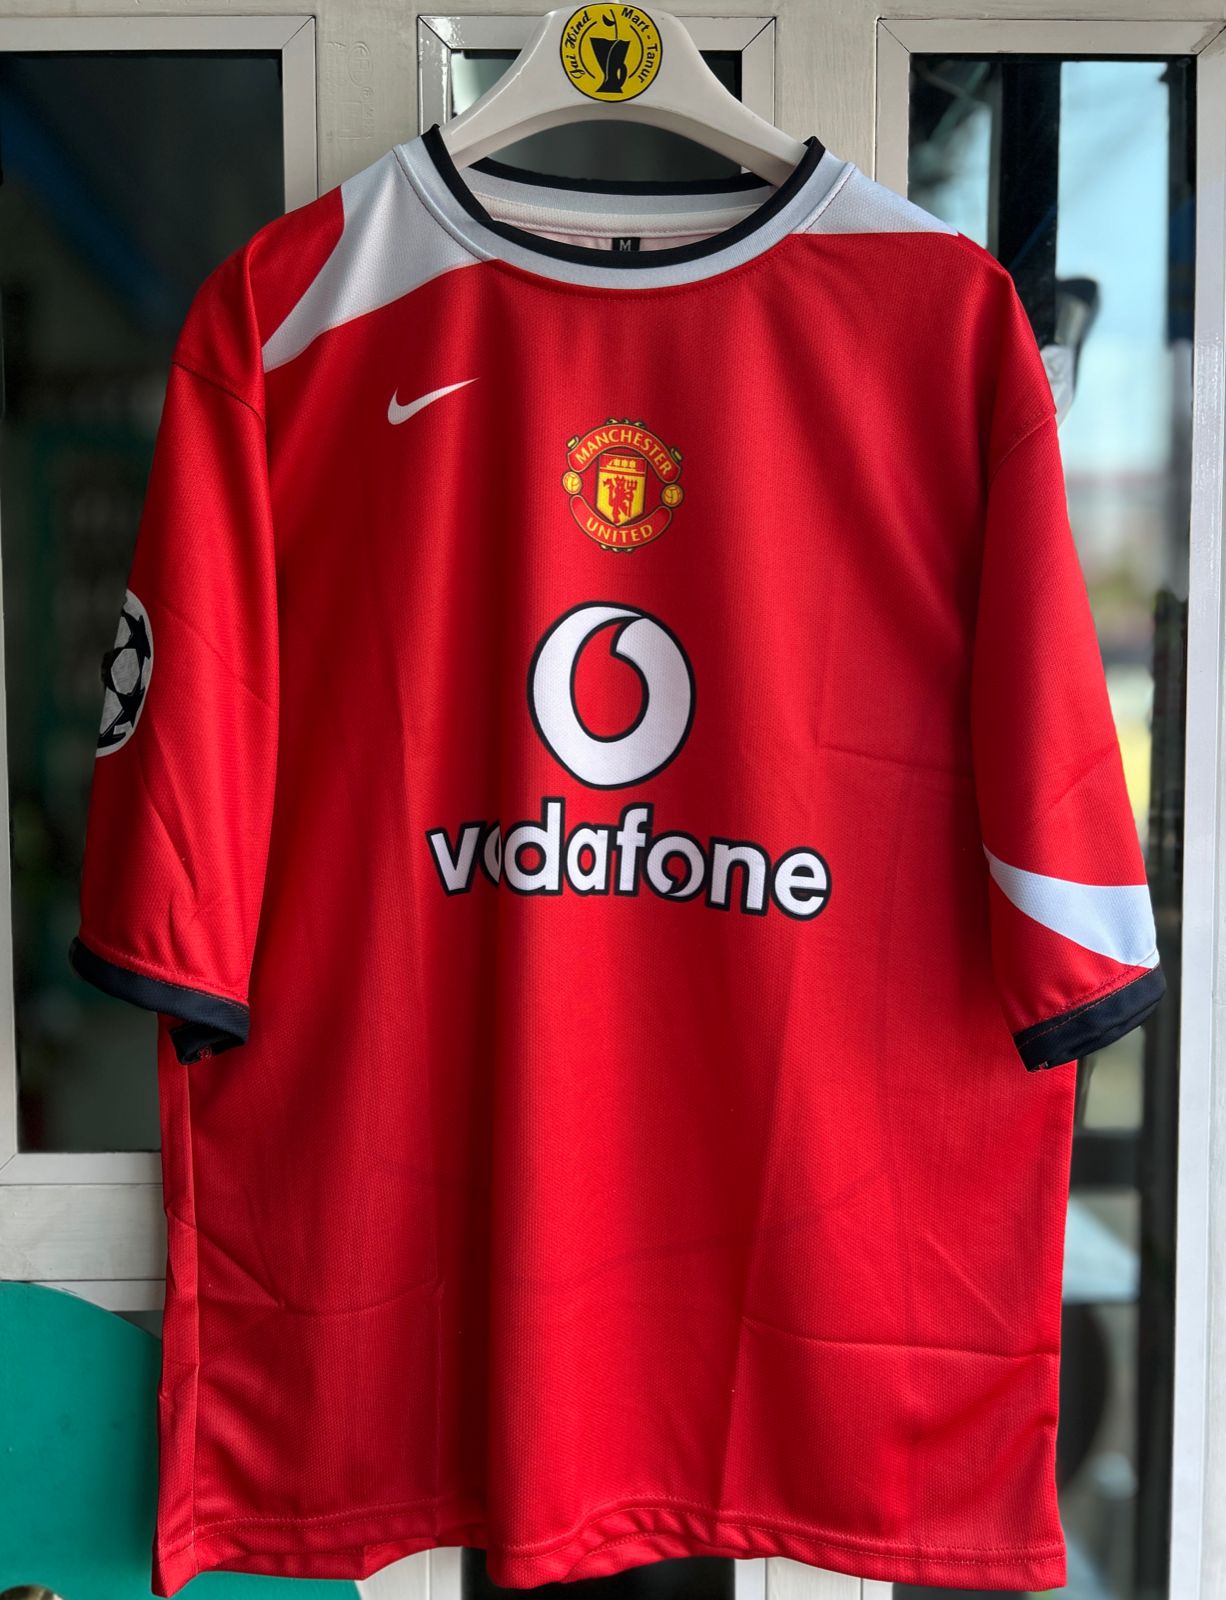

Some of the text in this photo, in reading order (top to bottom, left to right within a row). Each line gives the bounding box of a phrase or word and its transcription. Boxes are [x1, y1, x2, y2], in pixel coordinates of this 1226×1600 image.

[565, 10, 591, 49] Hind
[621, 7, 650, 33] Mart
[638, 43, 658, 83] Tanur
[619, 239, 632, 251] M
[575, 429, 672, 475] MANCHESTER
[586, 517, 653, 543] UNITED
[426, 796, 831, 921] vdafone
